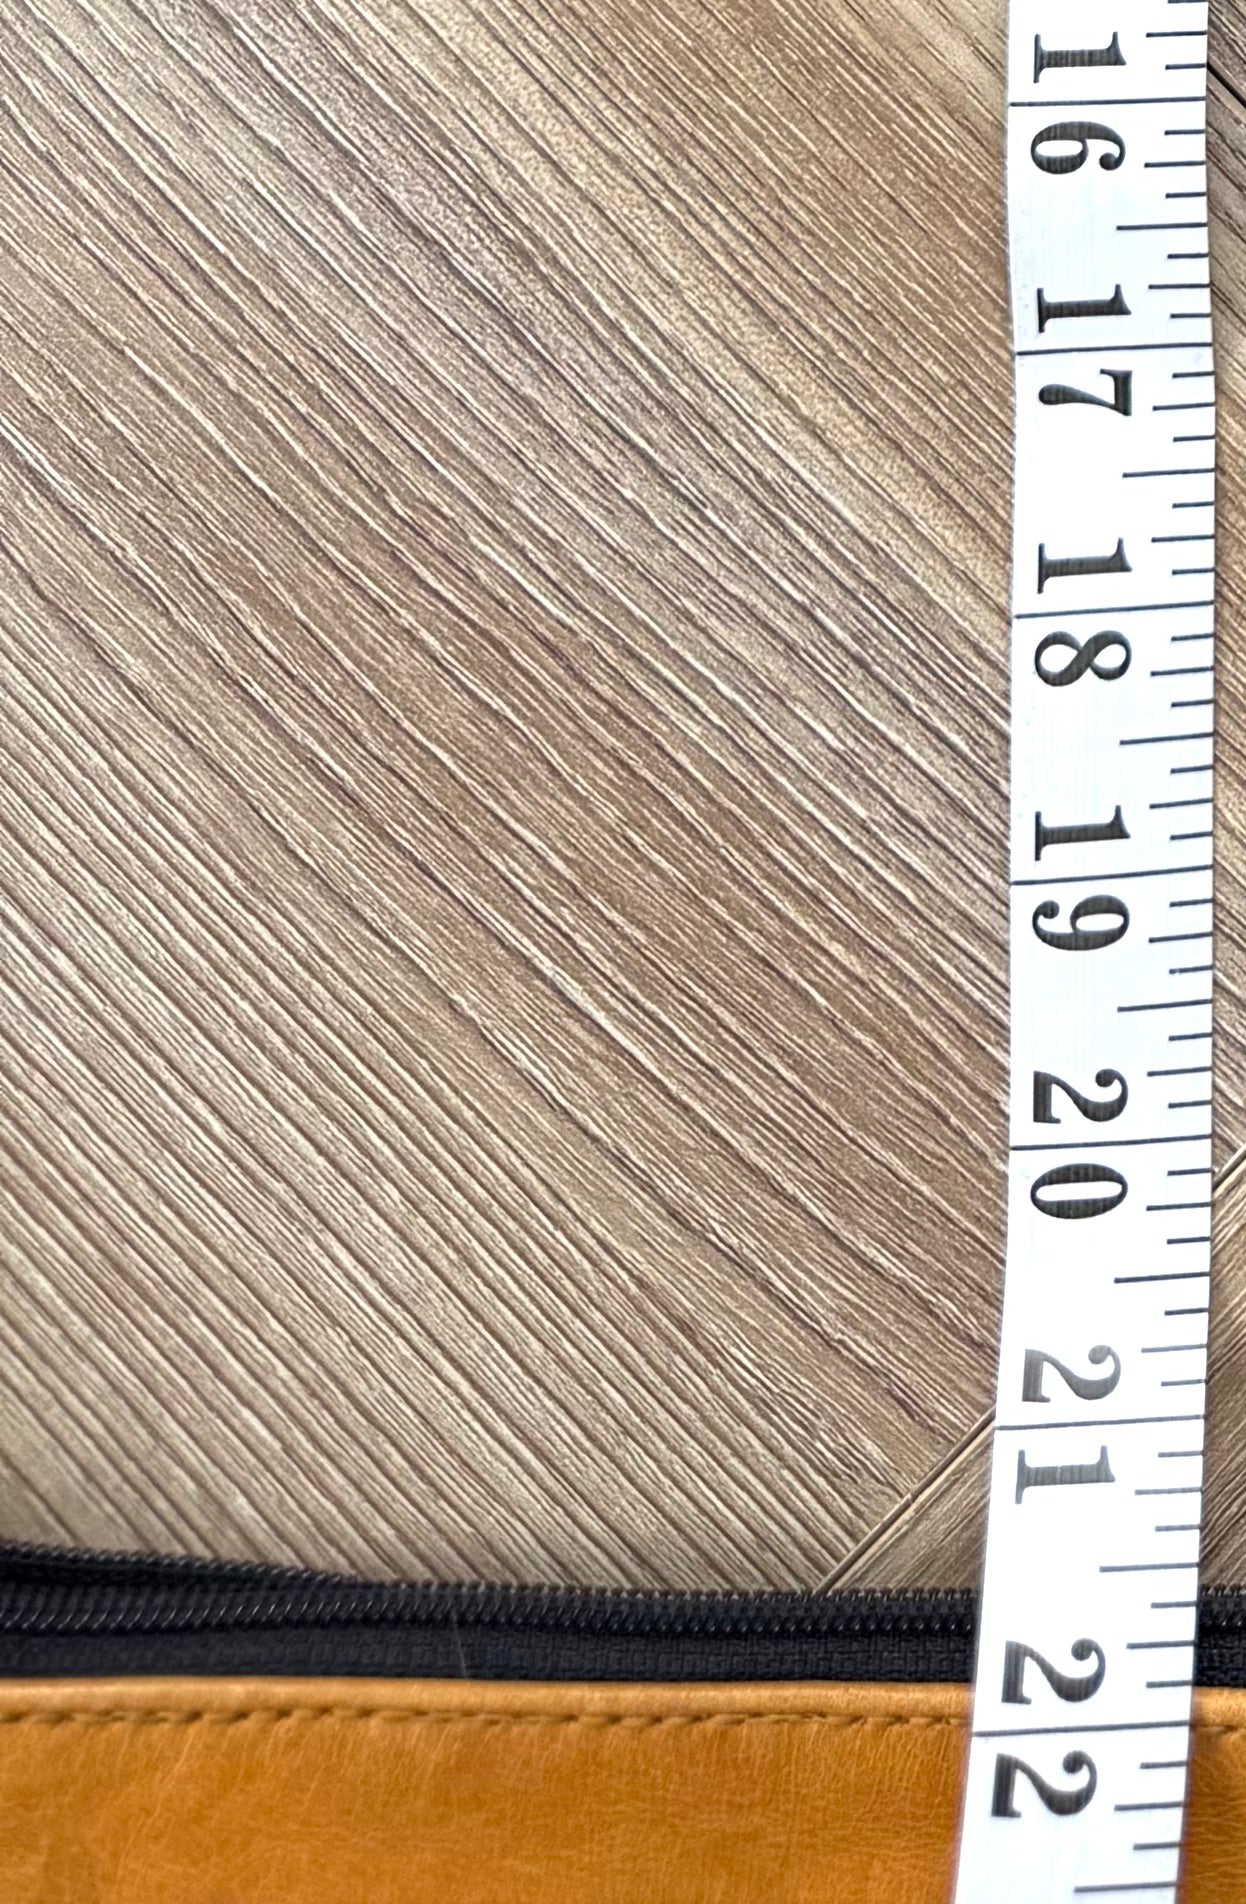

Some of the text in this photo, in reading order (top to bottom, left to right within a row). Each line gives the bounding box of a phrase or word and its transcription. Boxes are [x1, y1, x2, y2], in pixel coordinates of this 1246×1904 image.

[1031, 32, 1126, 174] 16
[1037, 284, 1132, 416] 17
[1034, 538, 1132, 687] 18
[1032, 806, 1130, 951] 19
[1030, 1069, 1128, 1219] 20
[1016, 1348, 1120, 1503] 21
[992, 1640, 1105, 1818] 22
